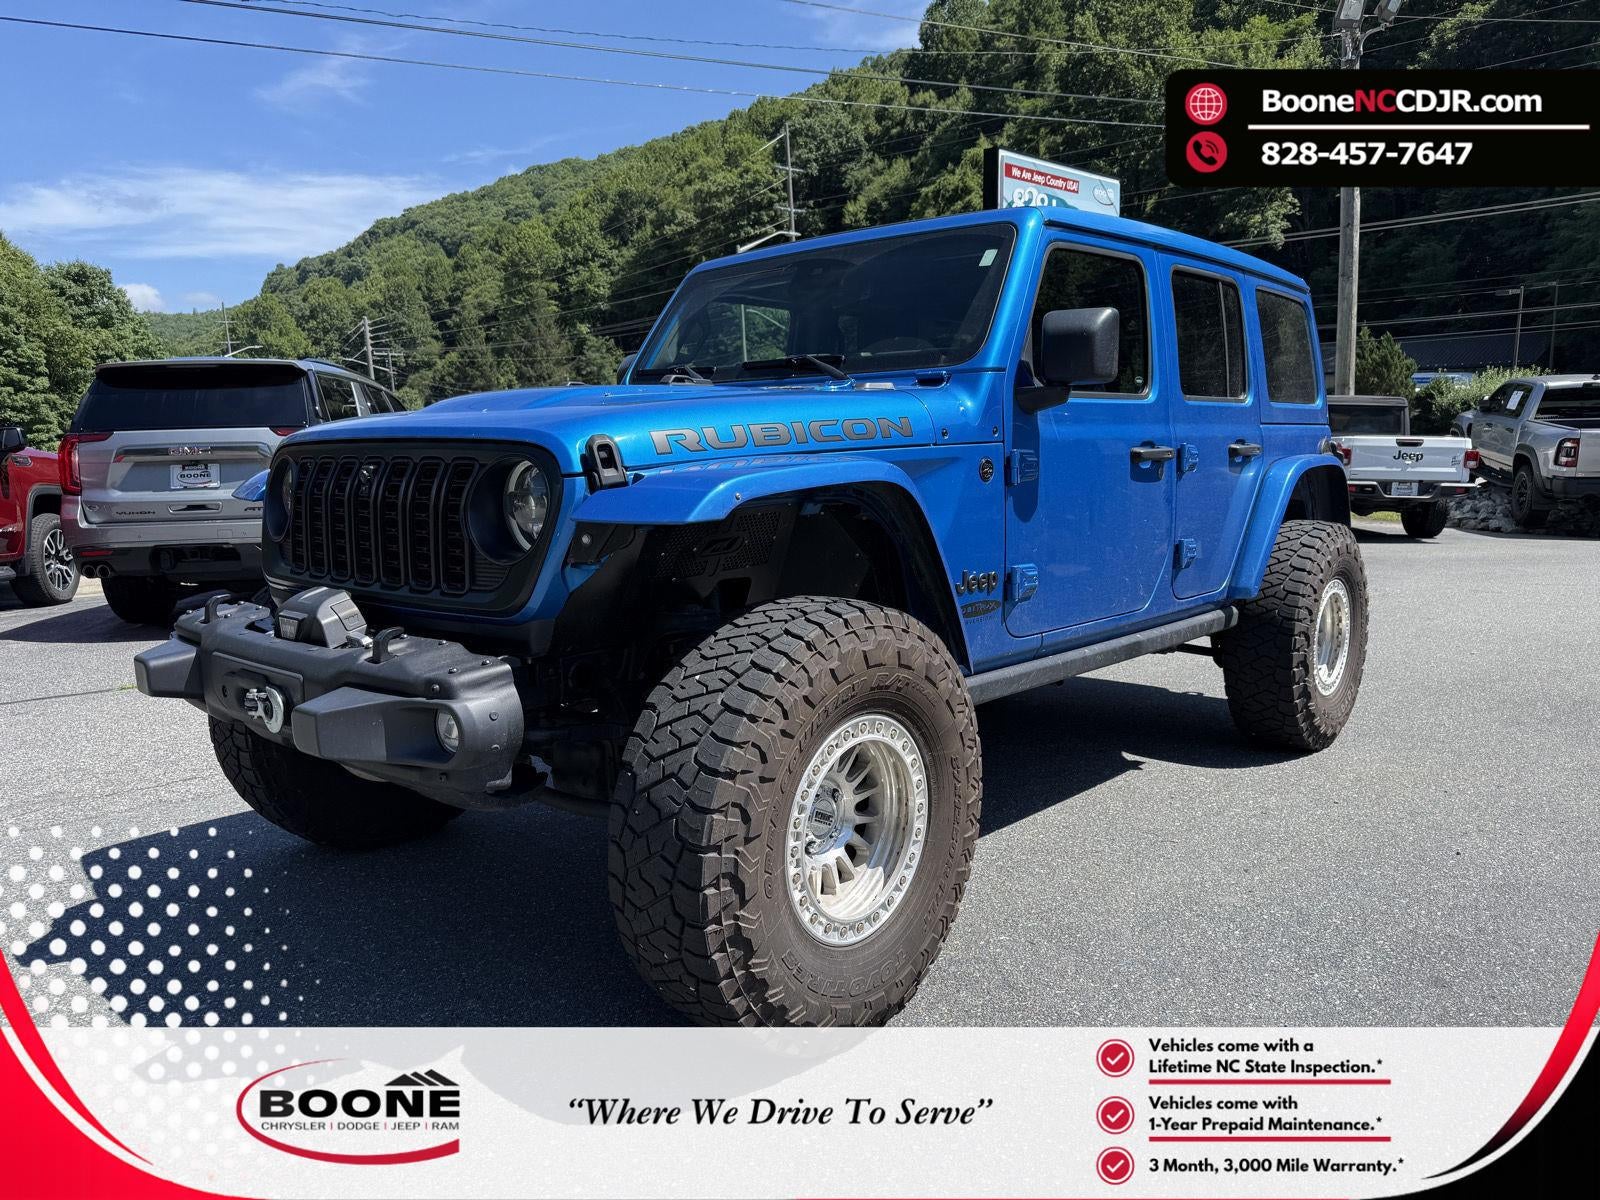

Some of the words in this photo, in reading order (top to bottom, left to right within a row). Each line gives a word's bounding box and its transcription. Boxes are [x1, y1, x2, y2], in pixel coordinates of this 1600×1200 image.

[1011, 166, 1021, 177] We
[1022, 169, 1032, 181] Are
[1032, 172, 1046, 185] Jeep
[1046, 176, 1067, 190] Country
[648, 416, 914, 455] RUBICON
[1393, 449, 1424, 462] Jeep
[955, 569, 999, 596] Jeep
